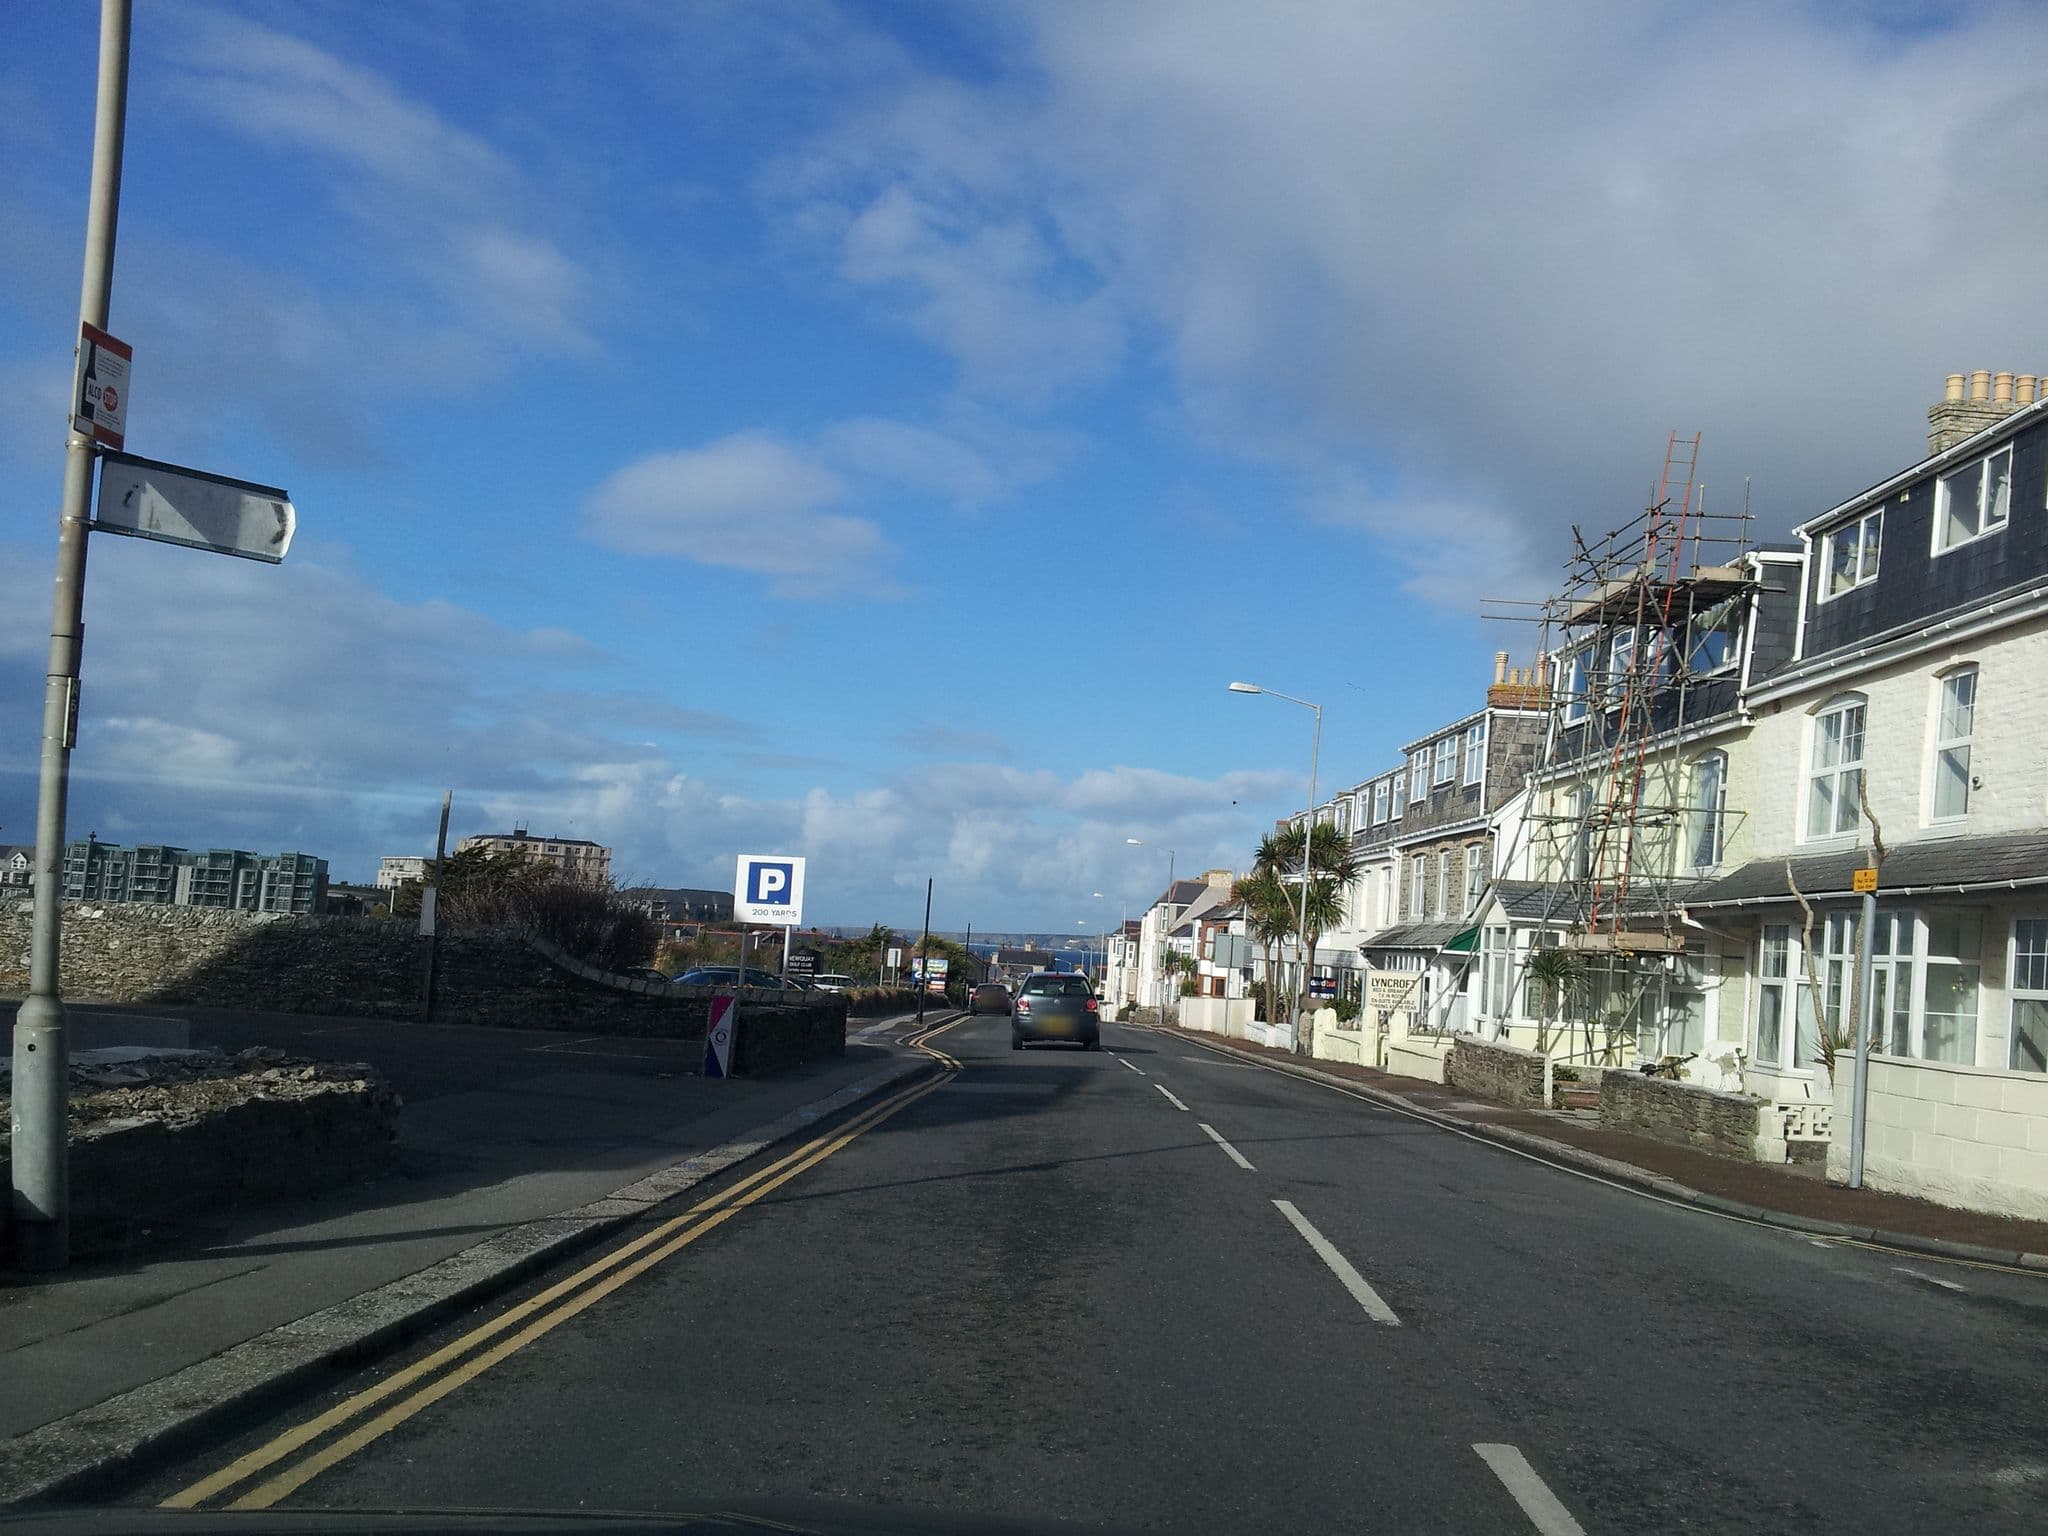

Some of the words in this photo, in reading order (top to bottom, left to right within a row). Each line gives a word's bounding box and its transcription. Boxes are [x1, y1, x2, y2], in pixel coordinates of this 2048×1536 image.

[758, 868, 786, 900] P
[752, 908, 769, 916] 200
[771, 909, 798, 917] YARDS
